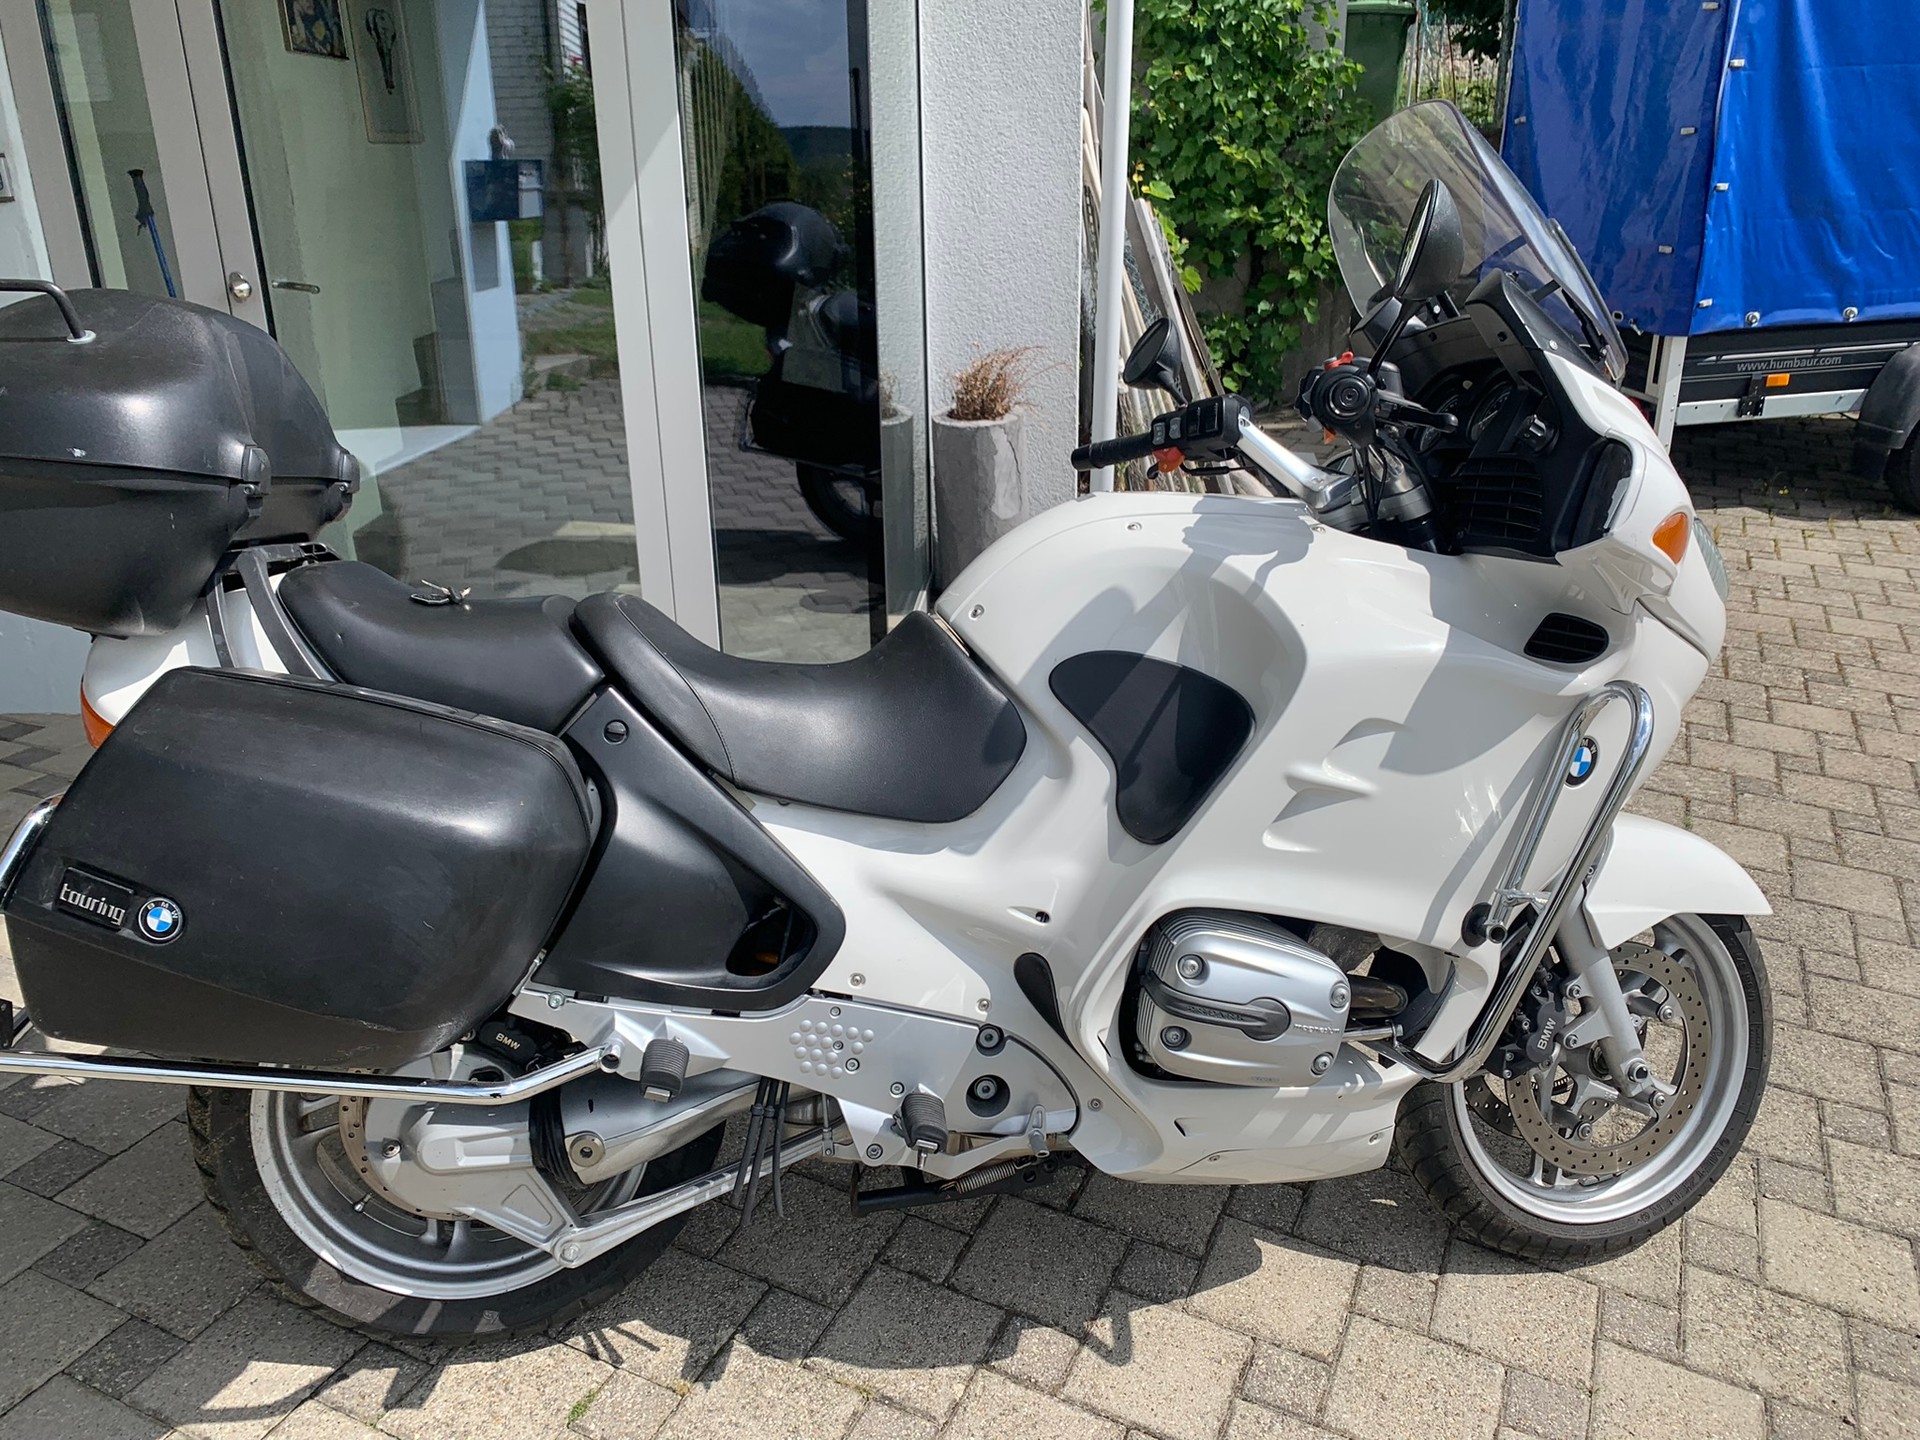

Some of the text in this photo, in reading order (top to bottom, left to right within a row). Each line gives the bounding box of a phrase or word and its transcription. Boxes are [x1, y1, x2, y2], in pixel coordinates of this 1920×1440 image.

[1737, 356, 1842, 371] www.humbaur.com
[59, 883, 126, 926] touring
[147, 902, 179, 919] BMW
[495, 1032, 520, 1050] BMW
[1537, 1017, 1557, 1050] BMW
